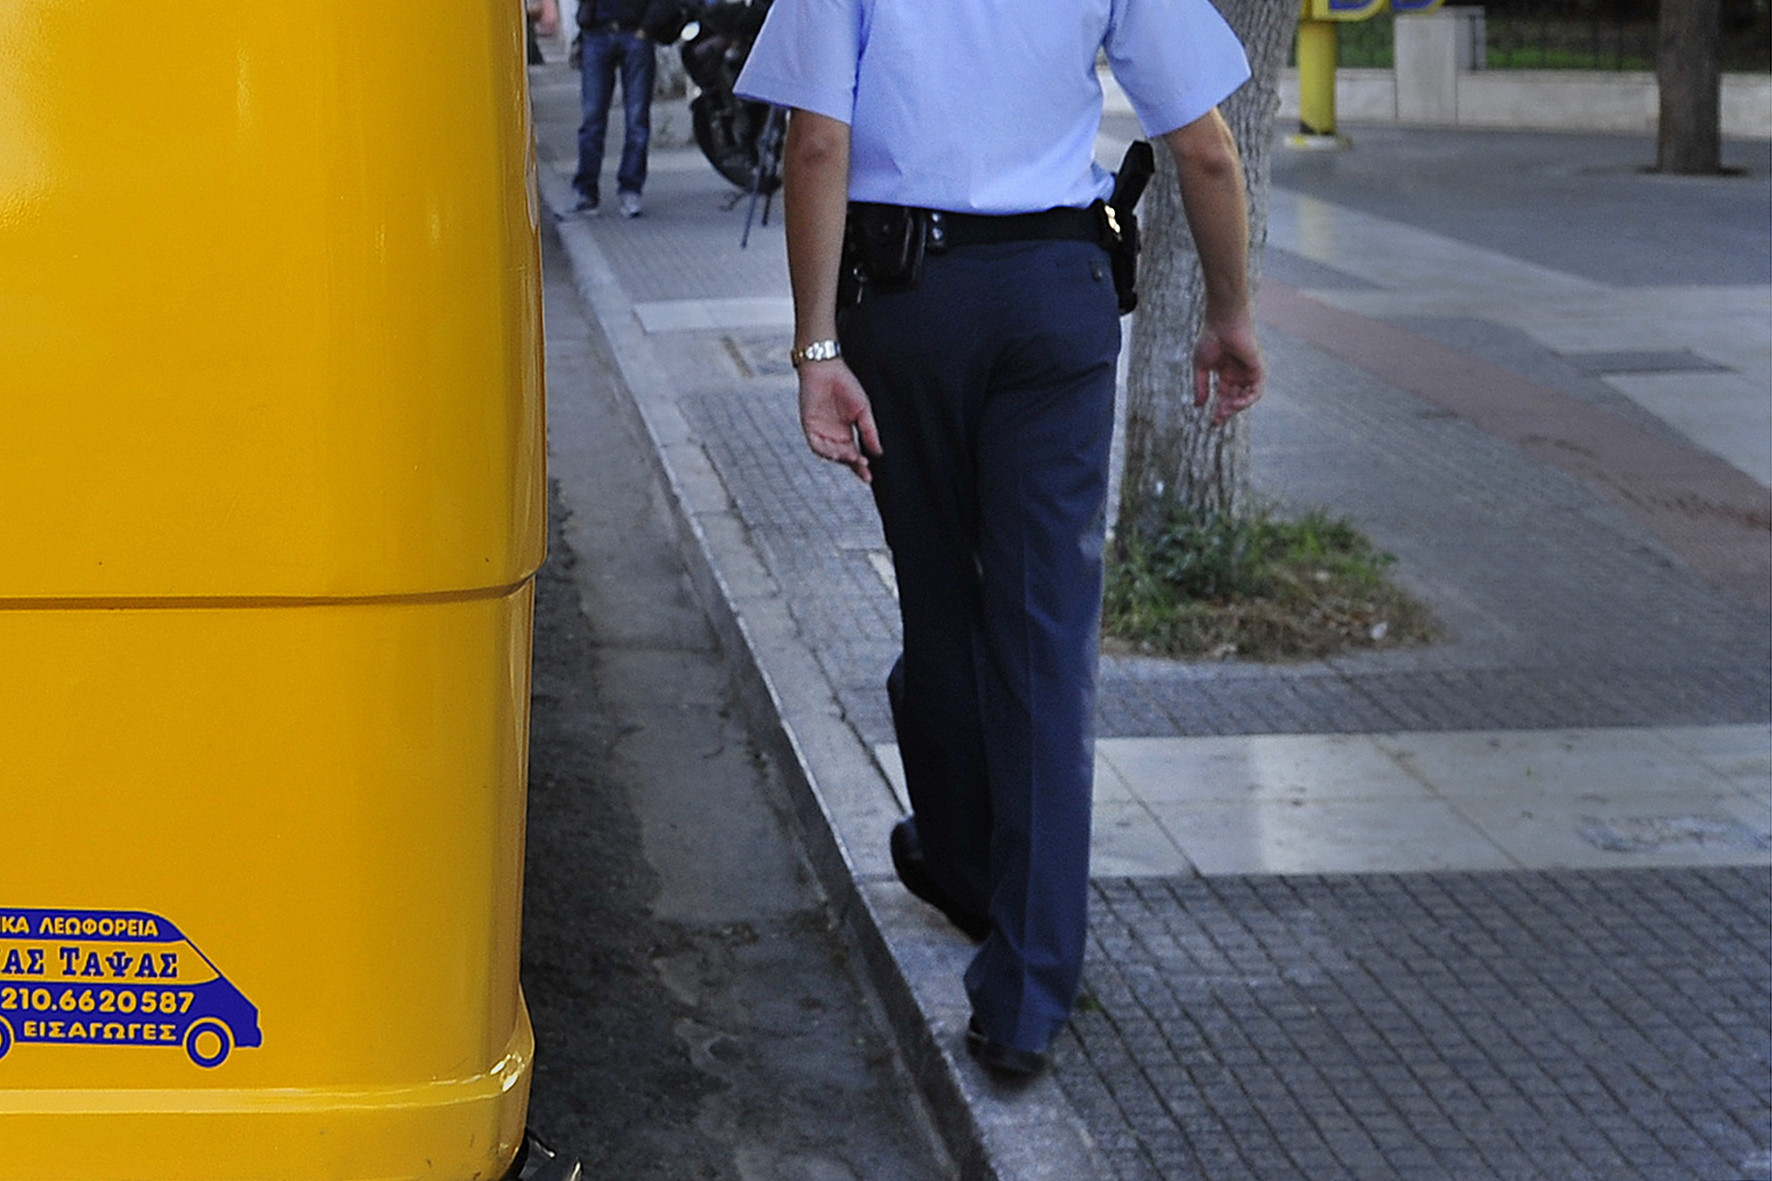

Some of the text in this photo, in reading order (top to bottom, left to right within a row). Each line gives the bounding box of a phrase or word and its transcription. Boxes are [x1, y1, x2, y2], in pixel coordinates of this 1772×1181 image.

[39, 916, 159, 937] ΛΕΩΦΟΡΕΙΑ
[59, 946, 178, 978] ΤΑΨΑΣ
[1, 987, 195, 1014] 210.6620587
[23, 1021, 177, 1041] ΕΙΣΑΓΩΓΕΣ
